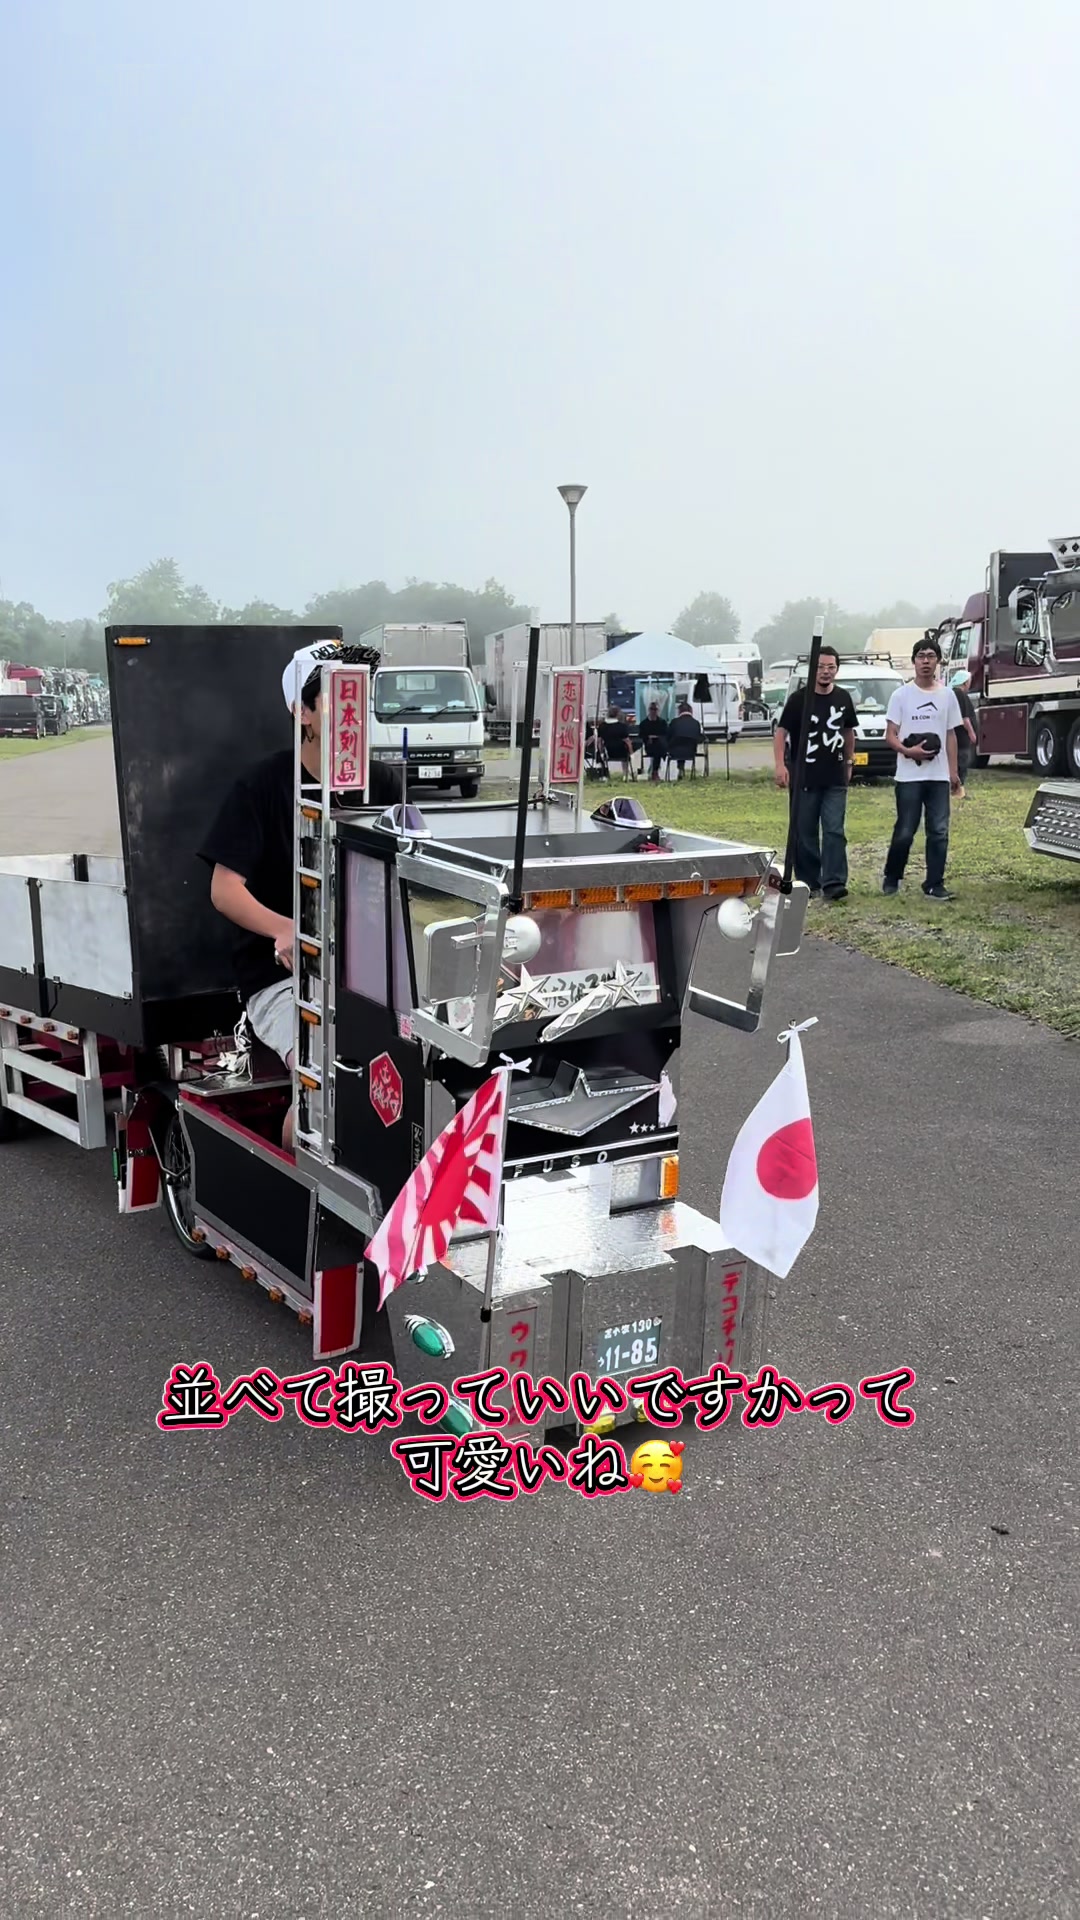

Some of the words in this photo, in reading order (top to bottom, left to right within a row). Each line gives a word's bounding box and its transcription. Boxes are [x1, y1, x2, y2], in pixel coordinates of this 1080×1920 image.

[336, 679, 360, 783] 日本列島
[557, 680, 577, 776] 恋の巡礼
[513, 1150, 608, 1177] FUSO
[632, 1317, 652, 1334] 130
[605, 1336, 658, 1372] 11-85
